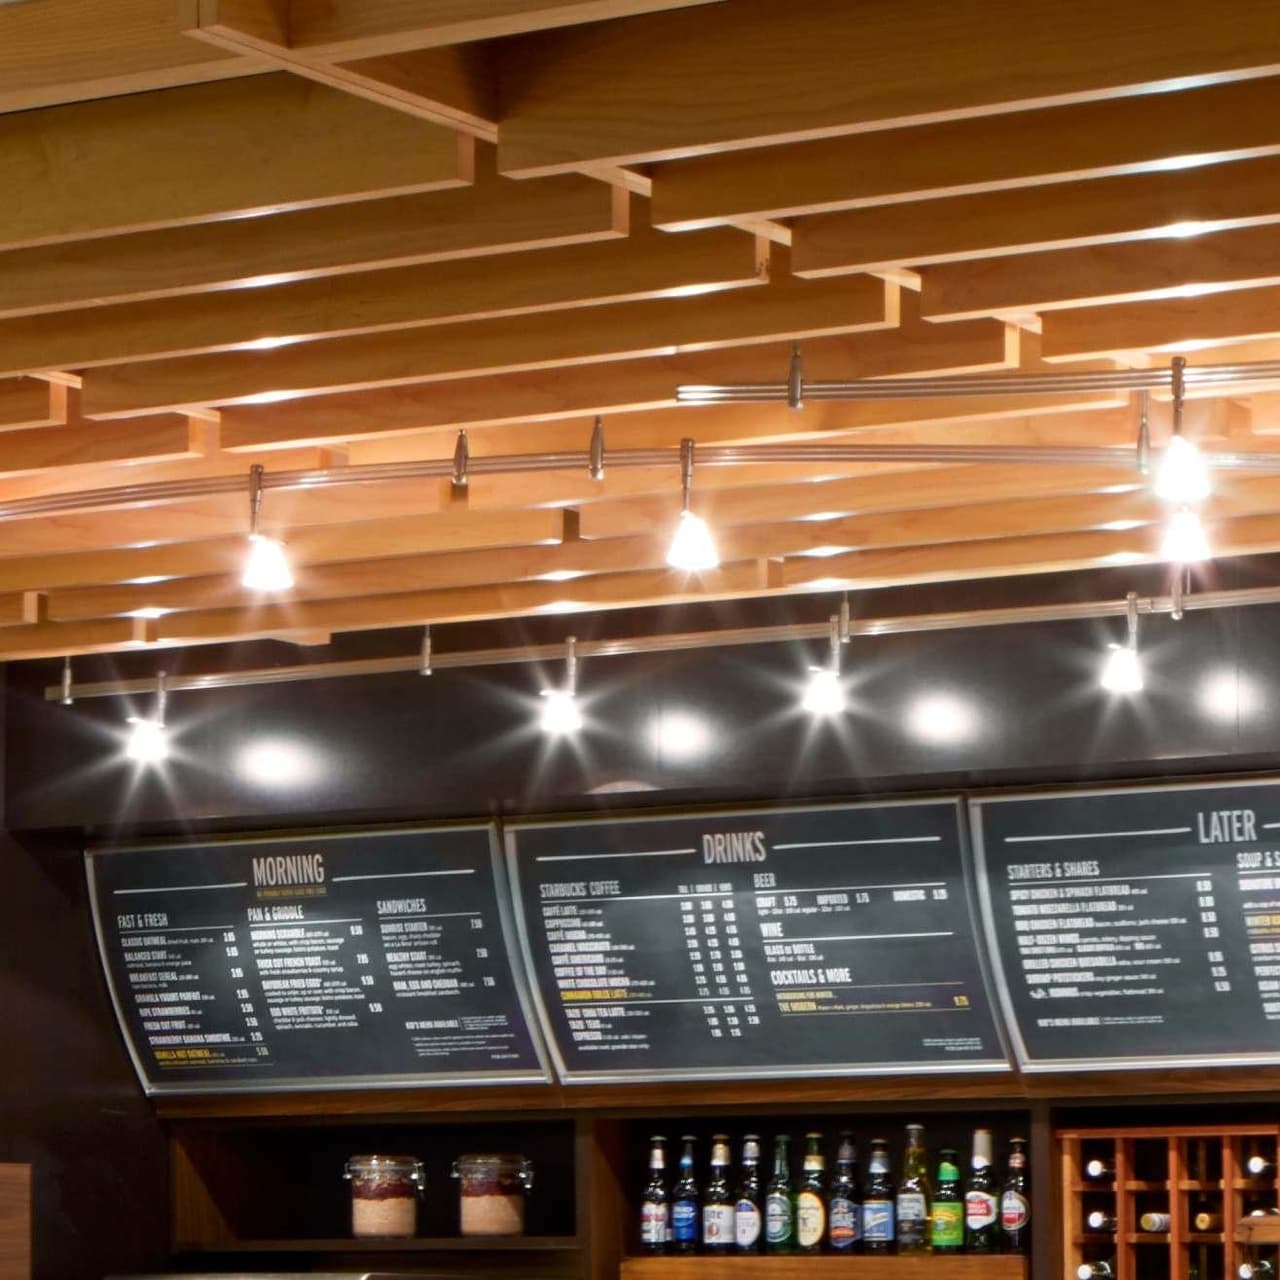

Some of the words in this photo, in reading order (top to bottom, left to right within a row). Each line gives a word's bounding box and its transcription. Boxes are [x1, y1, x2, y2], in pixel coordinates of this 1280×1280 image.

[1198, 810, 1257, 844] LATER
[702, 832, 767, 864] DRINKS
[1237, 853, 1262, 868] SOUP
[1264, 852, 1272, 867] &
[253, 854, 325, 886] MORNING
[1007, 863, 1052, 880] STARTERS
[1055, 862, 1062, 878] &
[1063, 860, 1100, 877] SHARES
[590, 881, 622, 895] COFFEE
[753, 873, 776, 888] BEER
[247, 908, 263, 921] PAN
[272, 905, 304, 920] GRIDDLE
[377, 898, 426, 914] SANDWICHES
[118, 914, 135, 929] FAST
[145, 913, 168, 927] FRESH
[760, 922, 784, 937] WINE
[771, 970, 816, 985] COCKTAILS
[817, 970, 825, 983] &
[827, 968, 852, 983] MORE
